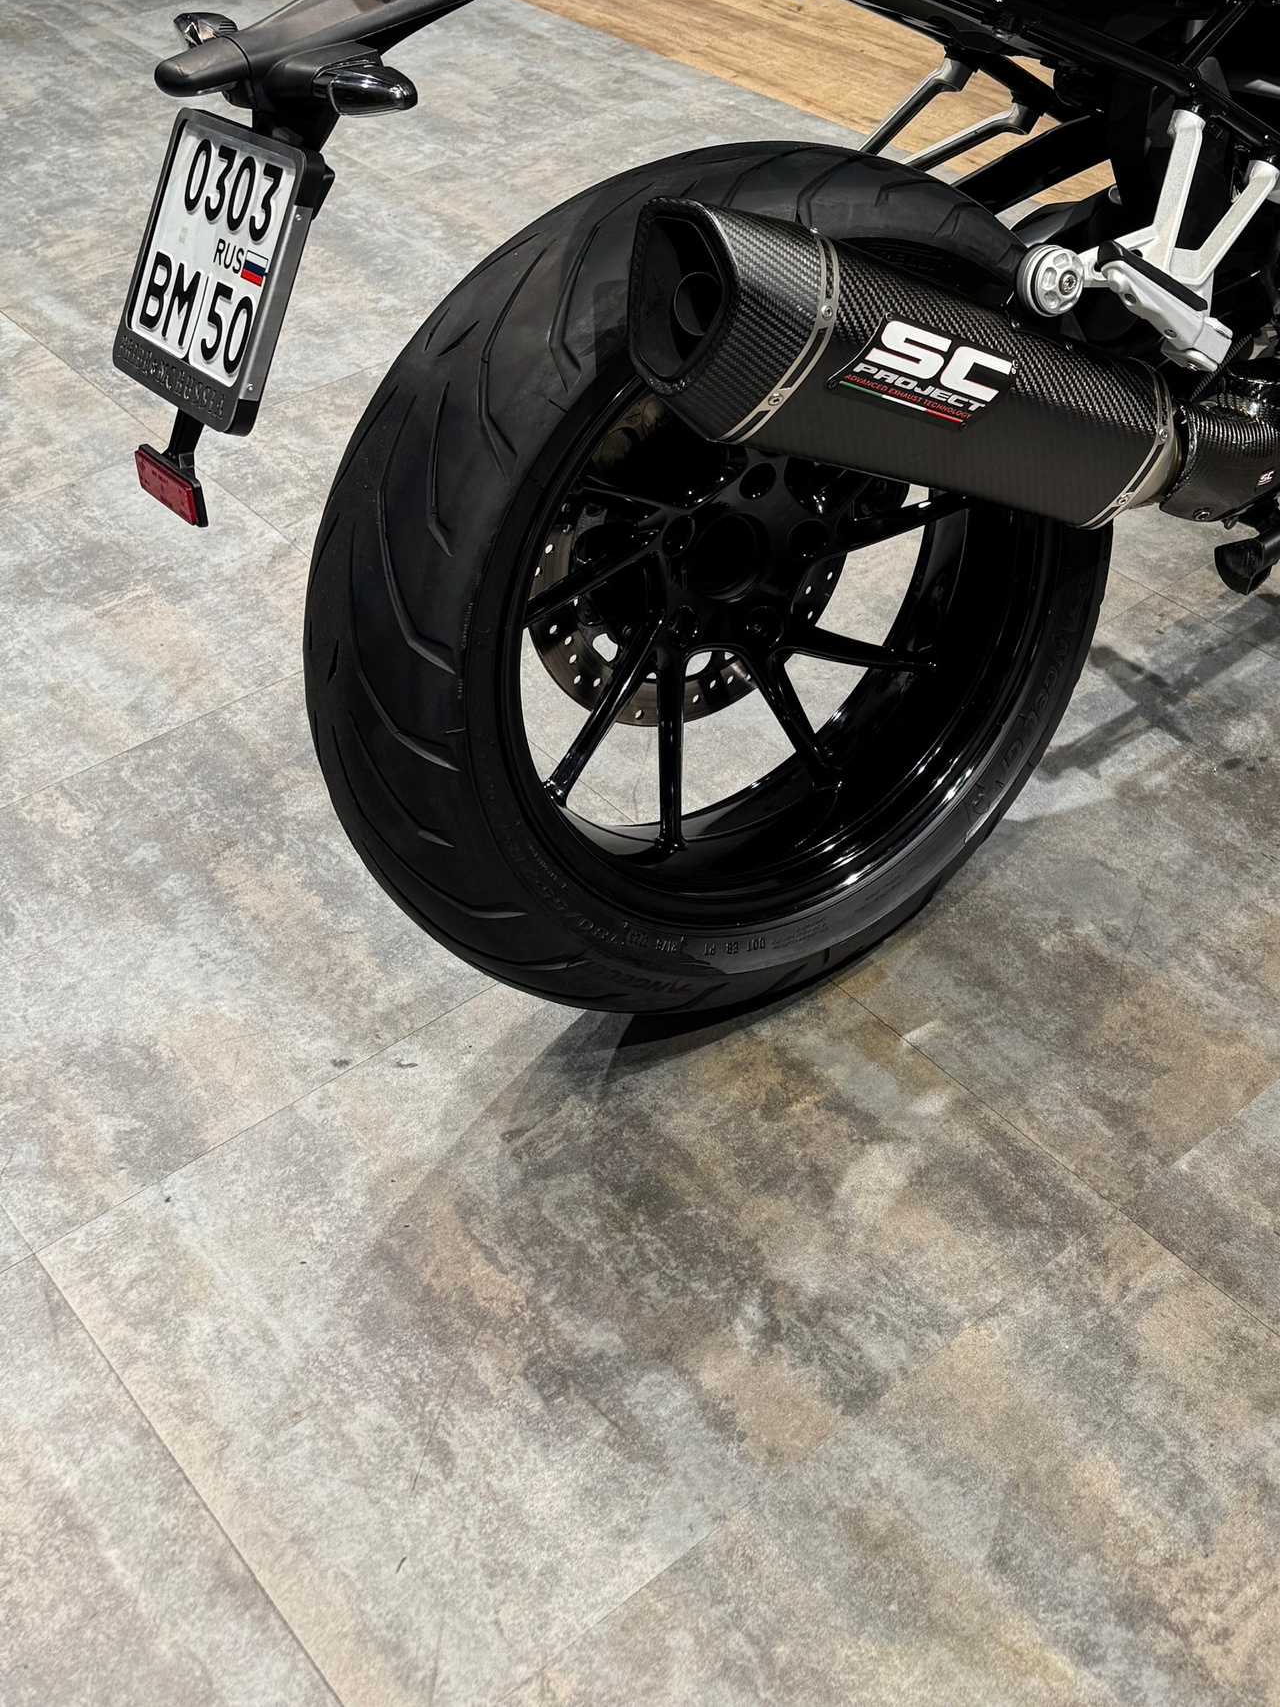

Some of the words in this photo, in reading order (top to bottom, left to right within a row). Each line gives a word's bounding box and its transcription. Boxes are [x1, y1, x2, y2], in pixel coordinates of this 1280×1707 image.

[183, 138, 284, 242] 0303
[213, 237, 245, 275] RUS
[138, 251, 202, 347] BM
[201, 281, 254, 375] 50
[852, 362, 985, 413] PROJECT
[865, 320, 1013, 403] SC
[844, 374, 888, 394] ADVANCED
[888, 388, 922, 404] EXHAUST
[923, 399, 973, 420] TECHNOLOGY
